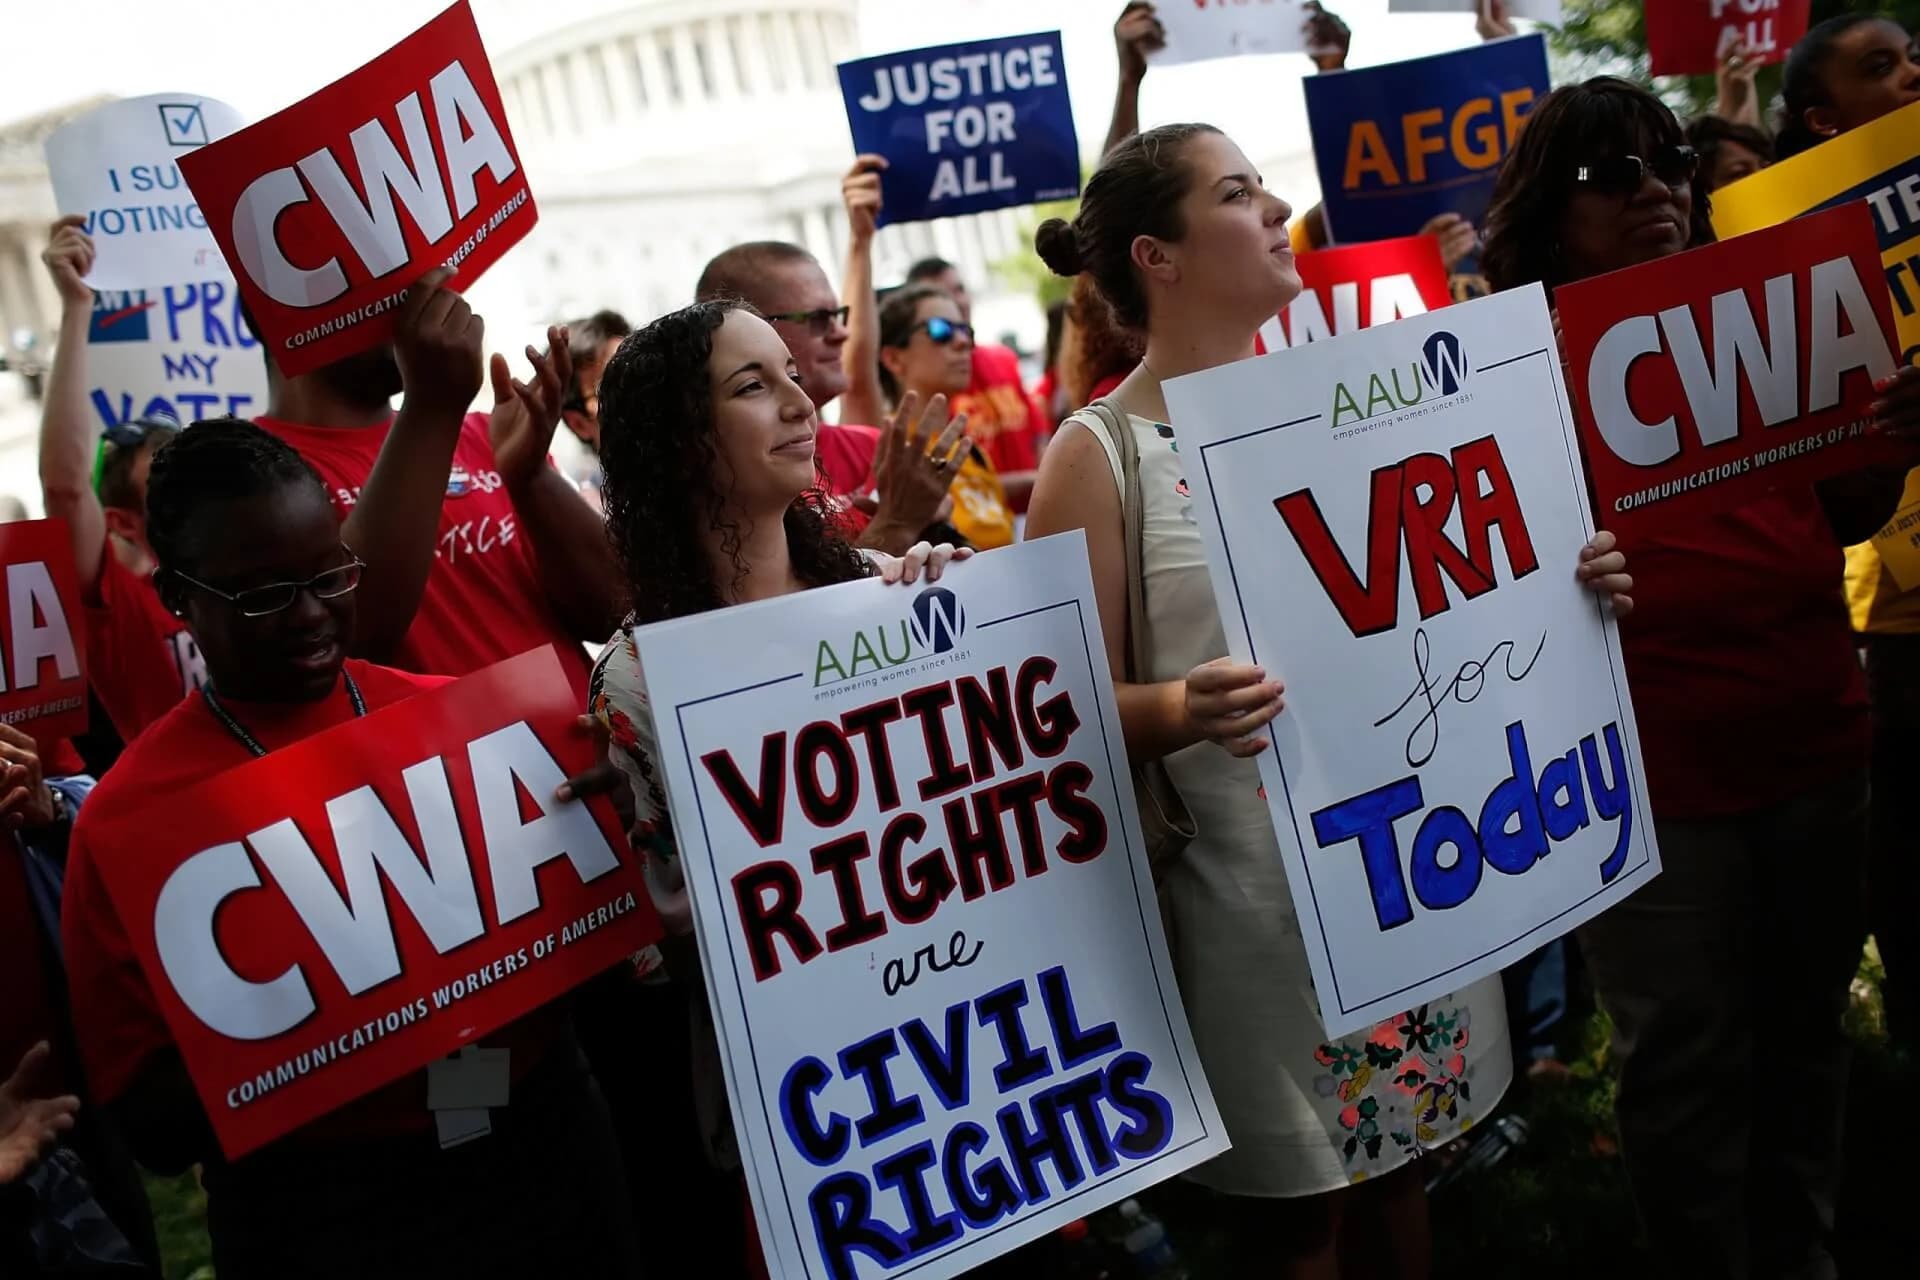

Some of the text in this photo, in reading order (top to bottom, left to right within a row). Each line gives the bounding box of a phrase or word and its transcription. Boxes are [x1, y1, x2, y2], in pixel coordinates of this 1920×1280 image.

[858, 45, 1058, 112] JUSTICE
[925, 102, 1017, 153] FOR
[79, 203, 208, 236] VOTING
[108, 168, 121, 193] I
[231, 59, 517, 308] CWA
[928, 153, 1017, 201] ALL
[441, 235, 476, 269] RKERS
[475, 223, 489, 243] OF
[489, 188, 528, 232] AMERICA
[161, 353, 219, 386] MY
[1331, 331, 1468, 428] AAUW
[1588, 255, 1899, 466] CWA
[1332, 417, 1393, 441] empowering
[1396, 408, 1428, 423] women
[1432, 400, 1454, 412] since
[1614, 457, 1751, 512] COMMUNICATIONS
[1754, 433, 1824, 468] WORKERS
[1827, 422, 1846, 443] OF
[1273, 433, 1540, 638] VRA
[0, 561, 81, 693] A
[813, 586, 966, 688] AAUW
[814, 650, 972, 700] empowering women since 1881
[1373, 627, 1548, 768] for
[700, 656, 1081, 848] VOTING
[731, 760, 1108, 982] RIGHTS
[1310, 719, 1633, 932] Today
[153, 720, 620, 1041] CWA
[227, 892, 637, 1108] COMMUNICATIONS WORKERS OF AMERICA
[882, 930, 984, 995] are
[778, 965, 1123, 1167] CIVIL
[808, 1051, 1174, 1280] RIGHTS
